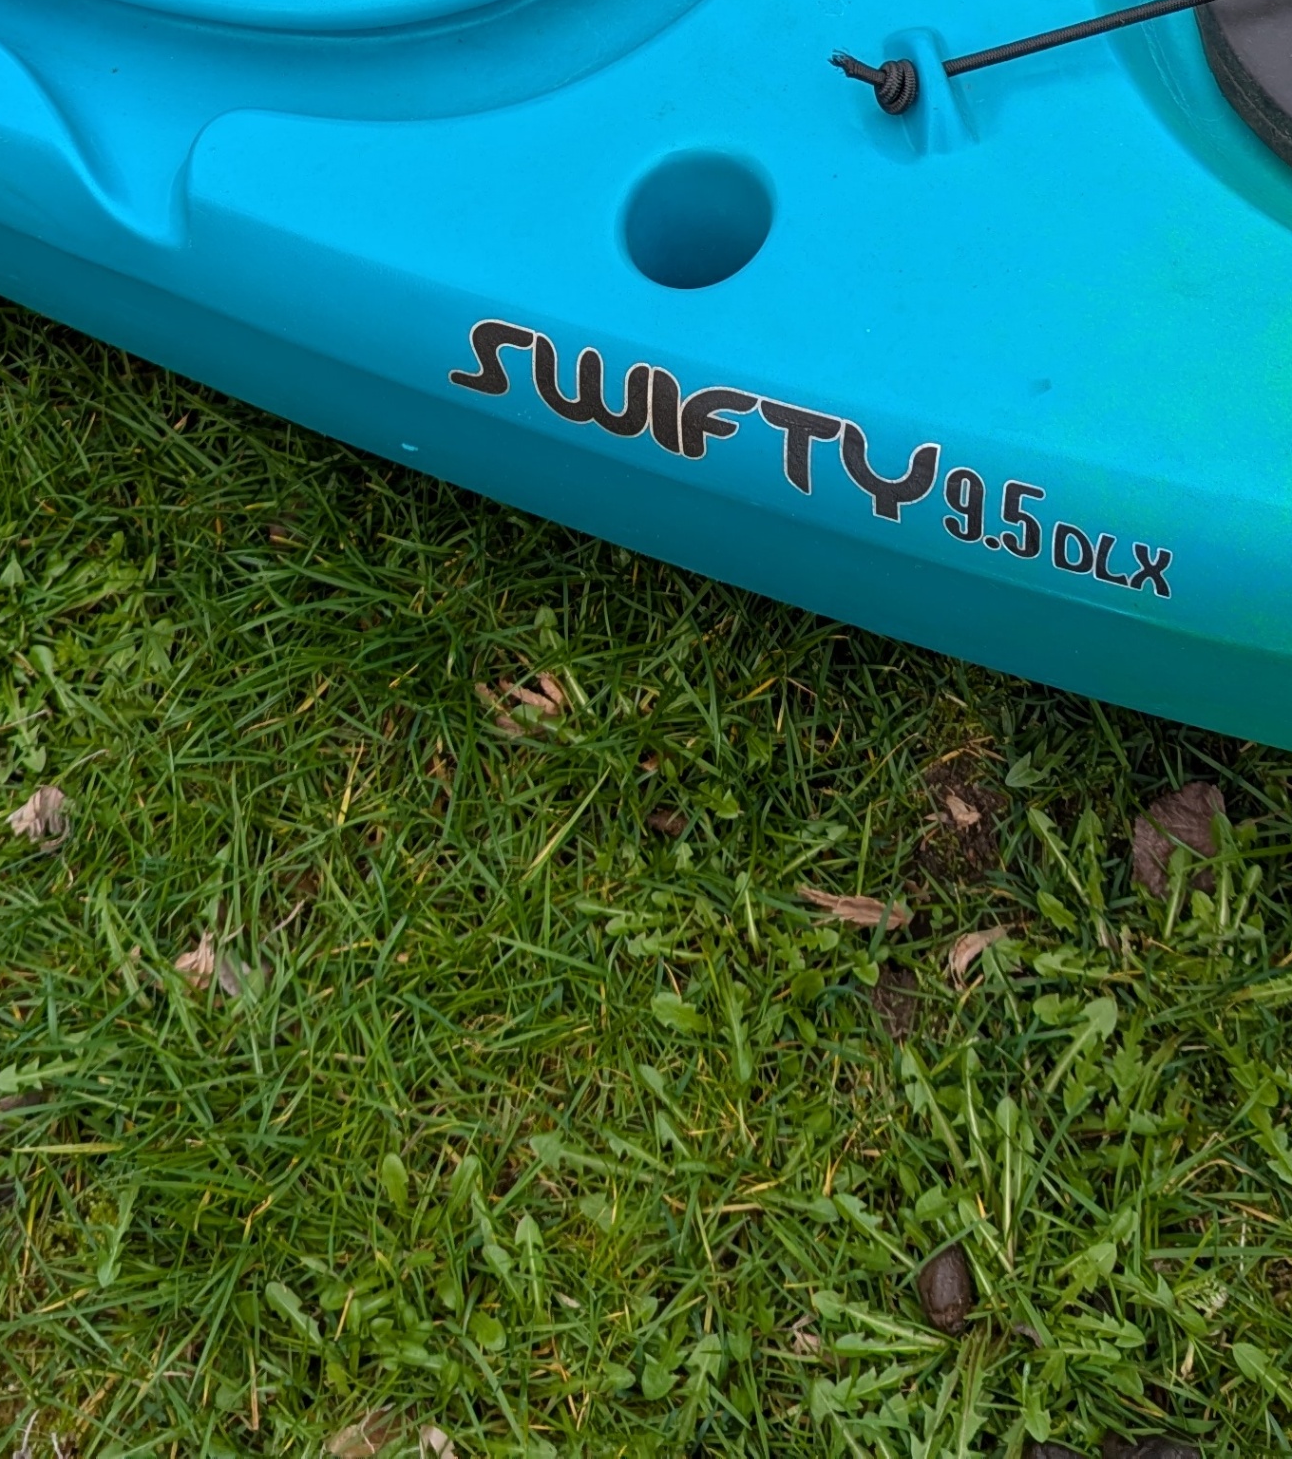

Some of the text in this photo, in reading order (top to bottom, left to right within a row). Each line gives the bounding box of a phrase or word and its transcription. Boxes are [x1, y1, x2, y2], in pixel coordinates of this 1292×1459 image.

[448, 319, 1173, 599] SWIFTY 9.5 DLX
